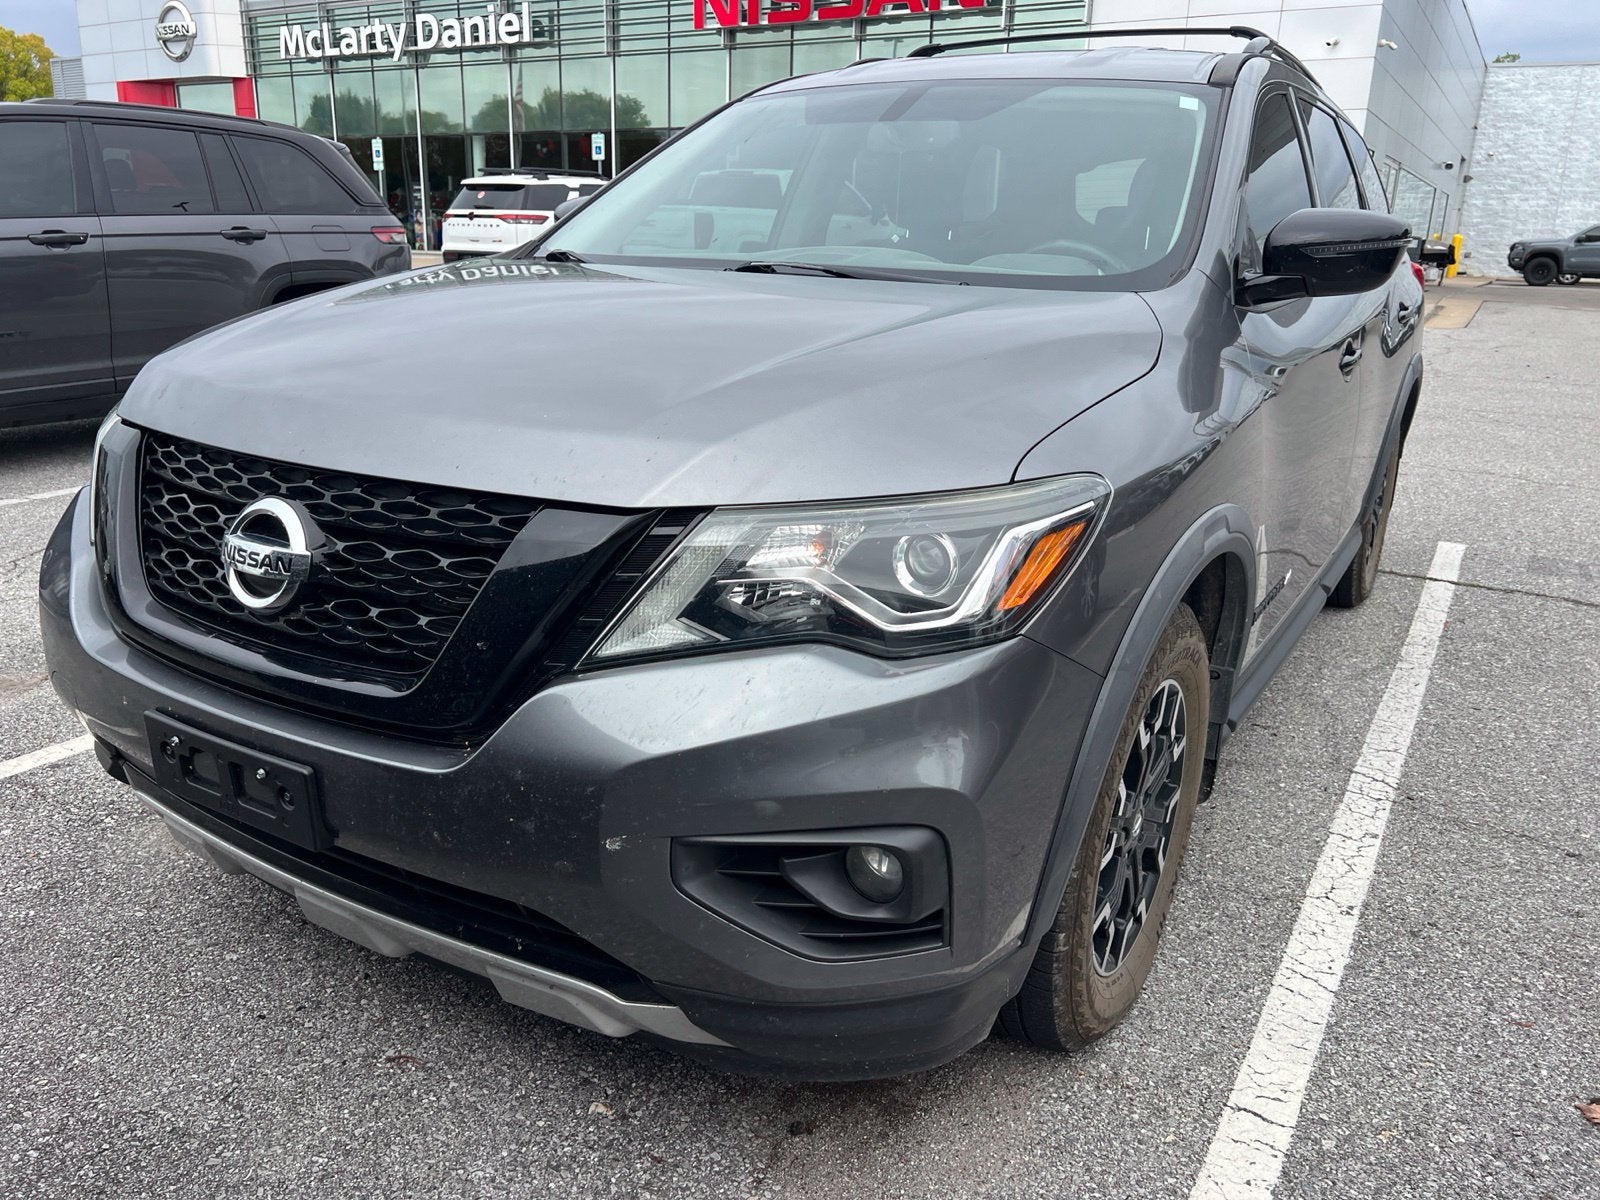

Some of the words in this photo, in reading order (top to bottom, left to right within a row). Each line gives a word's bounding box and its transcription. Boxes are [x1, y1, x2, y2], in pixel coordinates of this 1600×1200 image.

[279, 18, 407, 62] McLarty
[415, 2, 529, 49] Daniel
[692, 0, 986, 30] NISS
[223, 541, 292, 575] NISSAN
